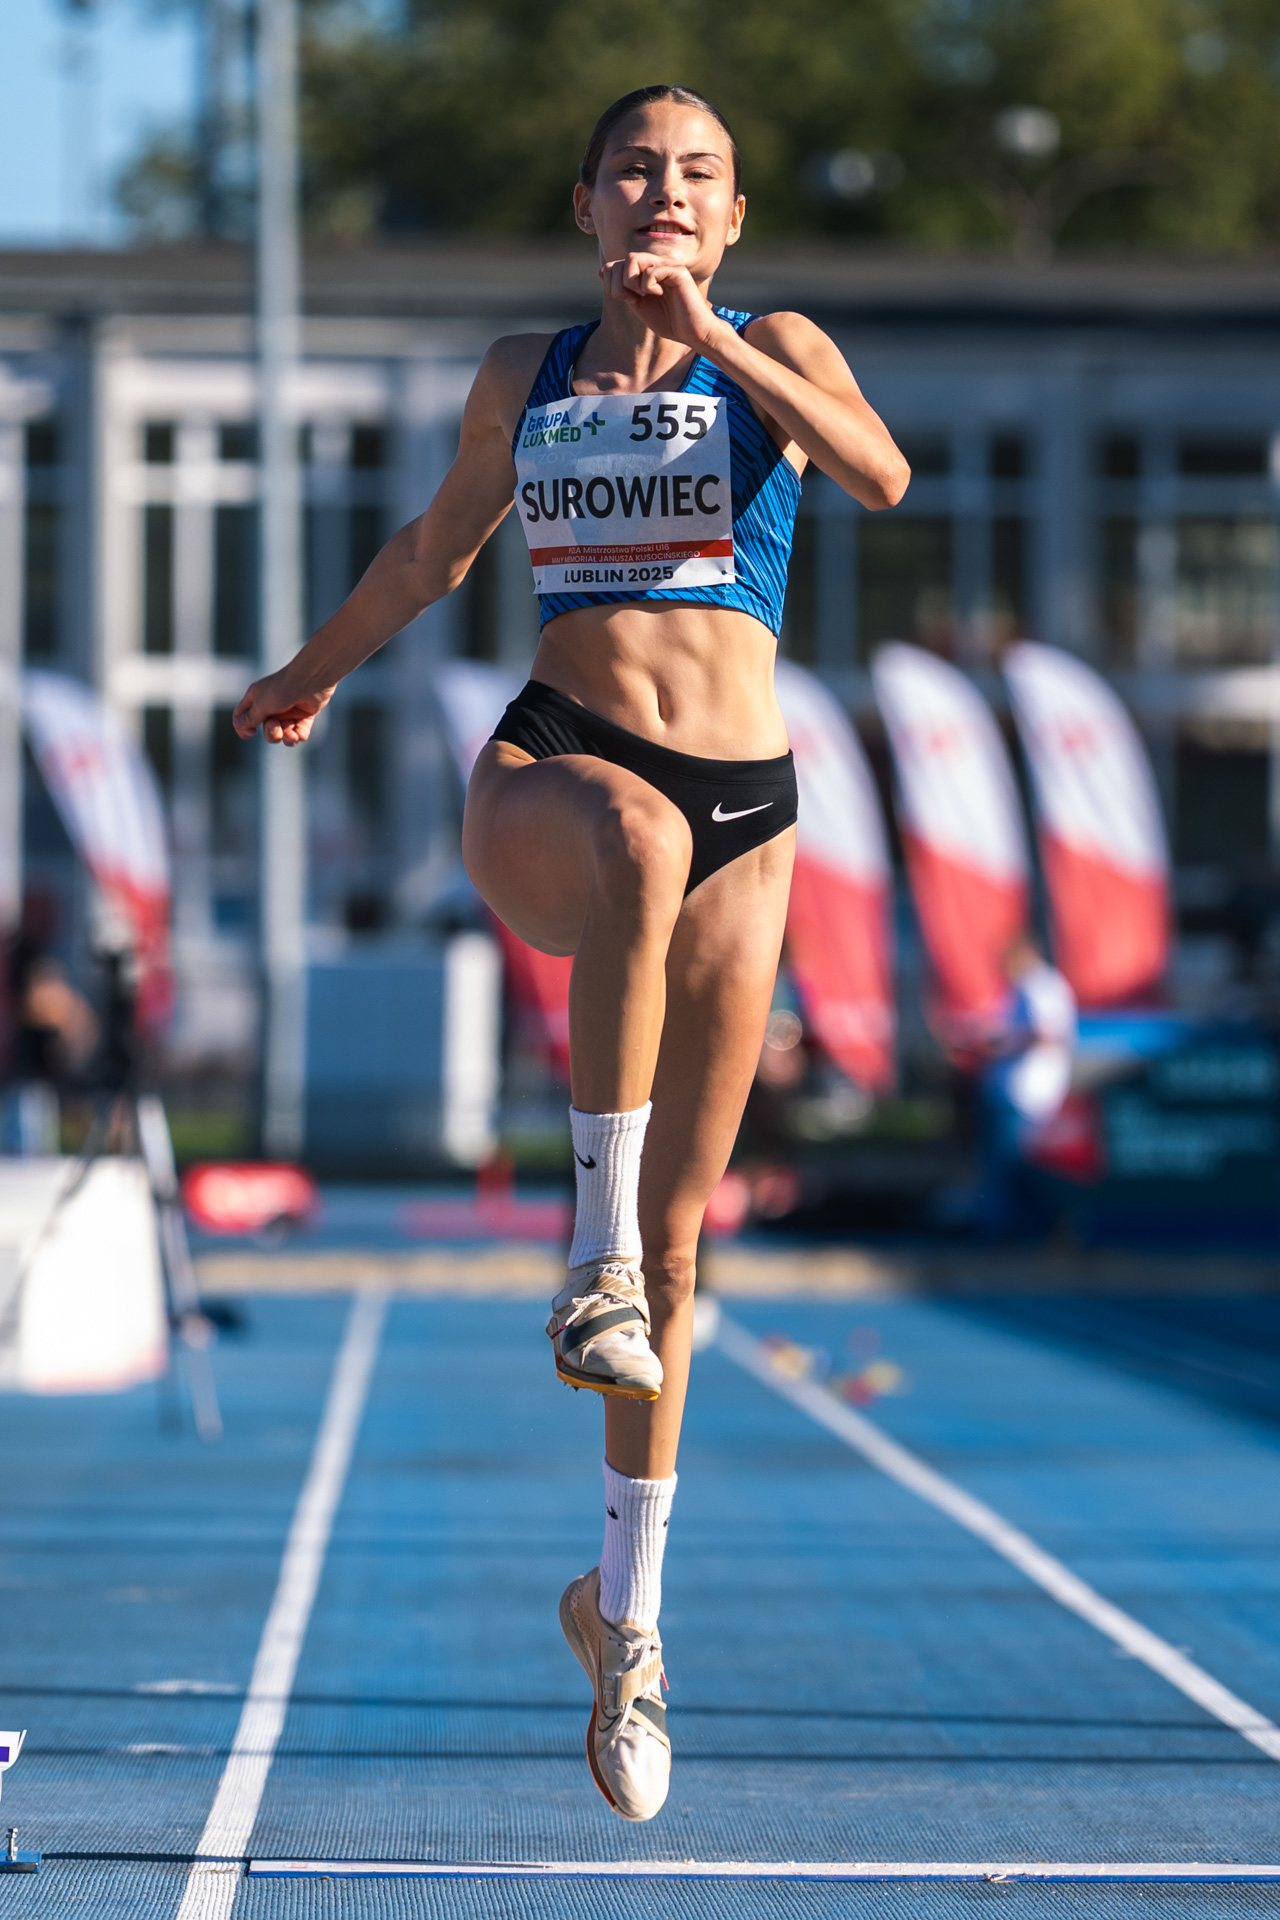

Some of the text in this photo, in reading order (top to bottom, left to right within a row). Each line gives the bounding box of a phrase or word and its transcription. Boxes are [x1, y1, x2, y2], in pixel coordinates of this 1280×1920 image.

[527, 410, 571, 433] GRUPA
[629, 404, 708, 441] 555
[522, 426, 582, 448] LUXMED
[521, 474, 721, 523] SUROWIEC
[583, 546, 630, 554] Mistrzostwa
[631, 544, 654, 553] Polski
[655, 544, 670, 552] U16
[599, 554, 634, 562] JANUSZA
[635, 550, 701, 561] KUSOCIŃSKIEGO
[564, 566, 674, 583] LUBLIN 2025
